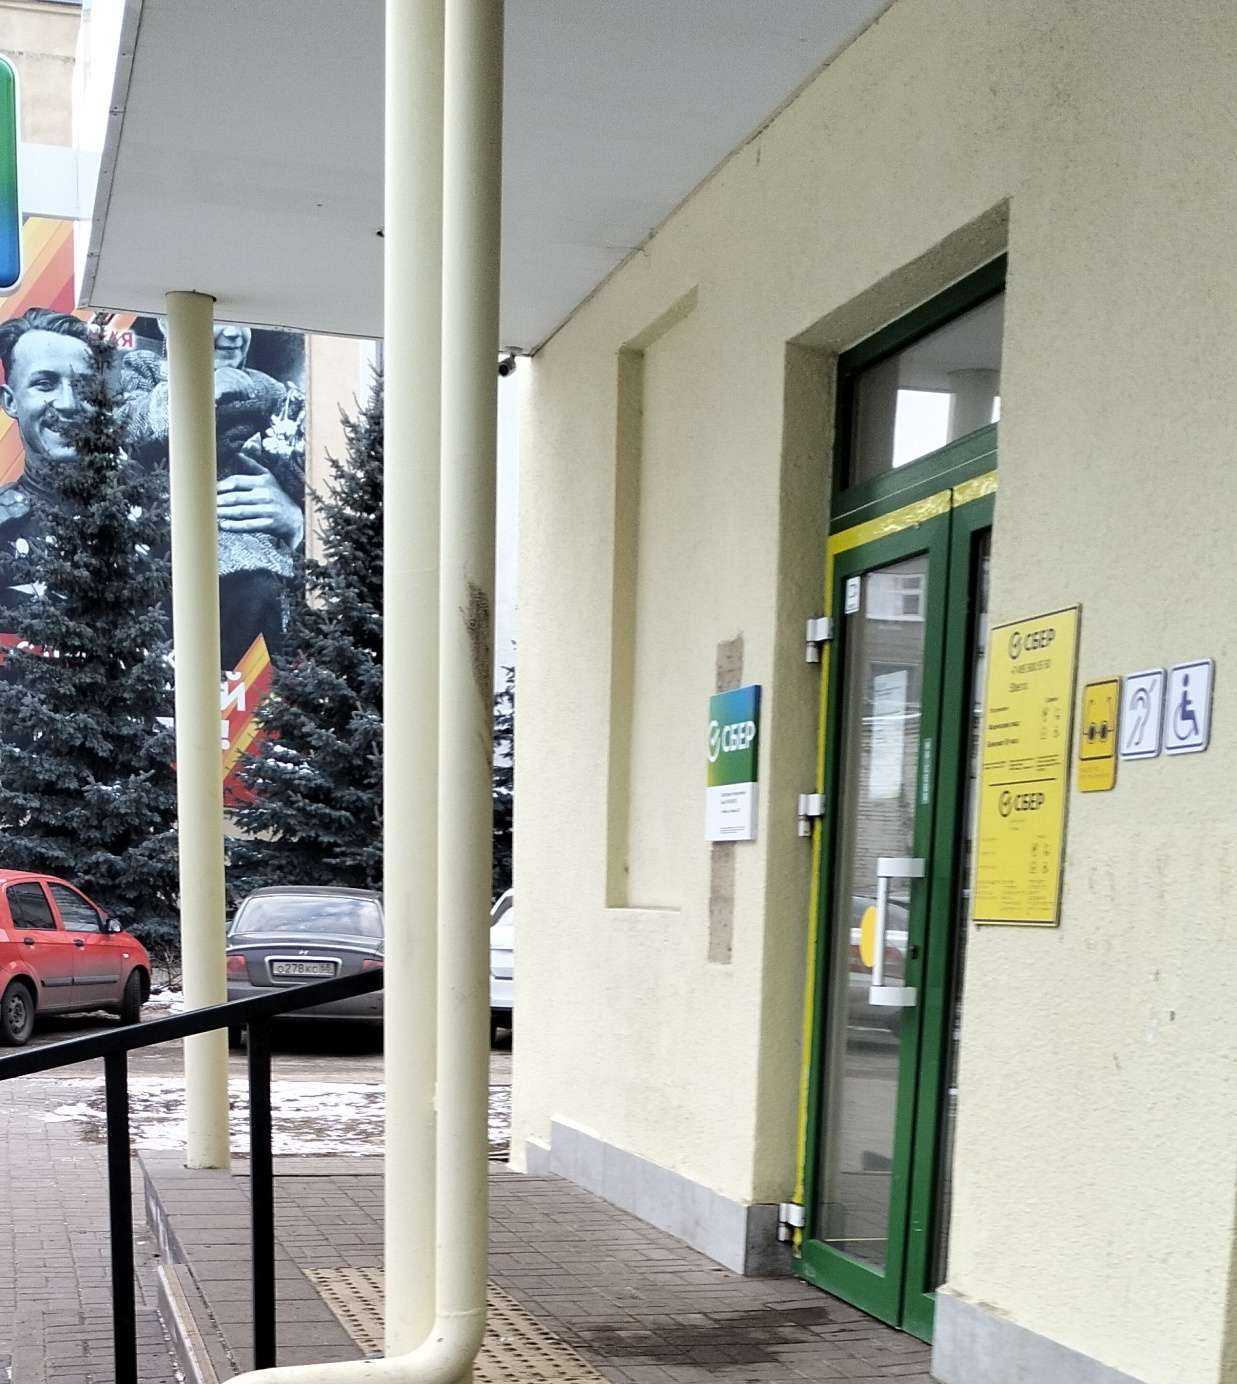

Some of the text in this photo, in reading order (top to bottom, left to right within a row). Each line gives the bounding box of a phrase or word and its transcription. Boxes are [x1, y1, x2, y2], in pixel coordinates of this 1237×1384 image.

[1024, 628, 1056, 651] СБЕР
[722, 721, 756, 752] СБЕР
[1014, 792, 1045, 811] СБЕР
